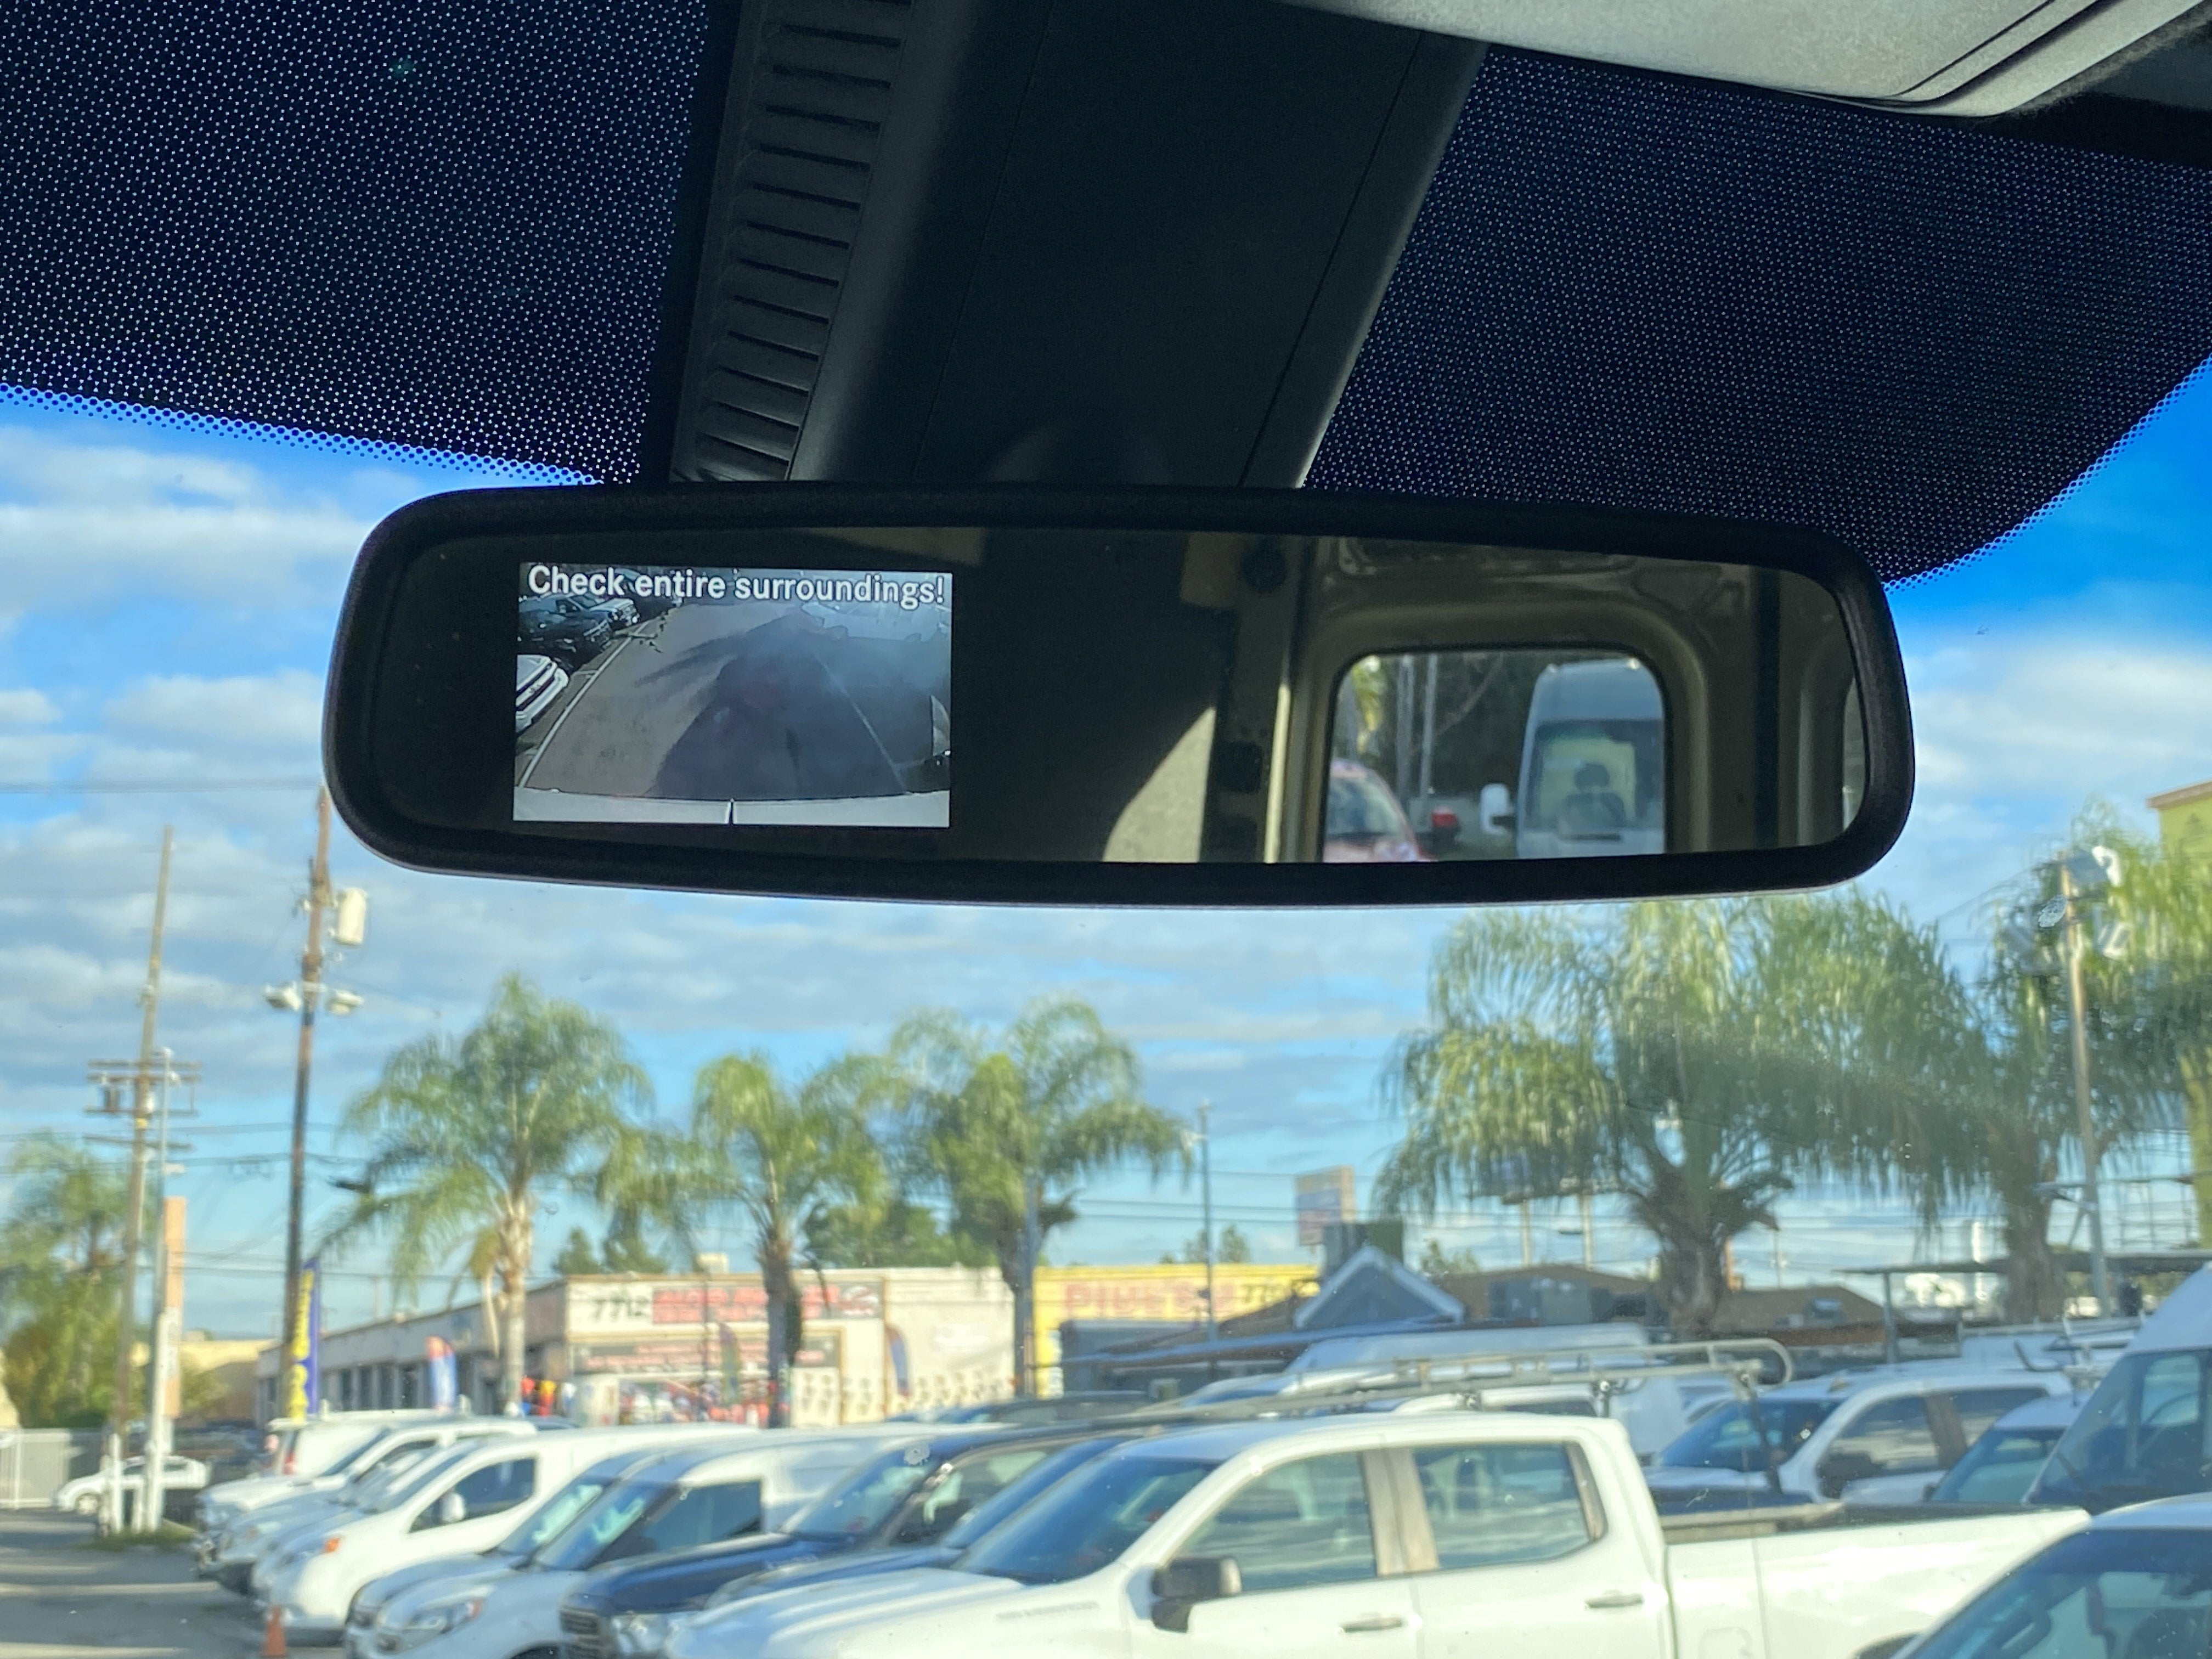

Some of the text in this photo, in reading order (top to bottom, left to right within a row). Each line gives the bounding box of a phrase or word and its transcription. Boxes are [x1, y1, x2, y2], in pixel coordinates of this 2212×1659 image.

[527, 563, 946, 611] Check entire surroundings!
